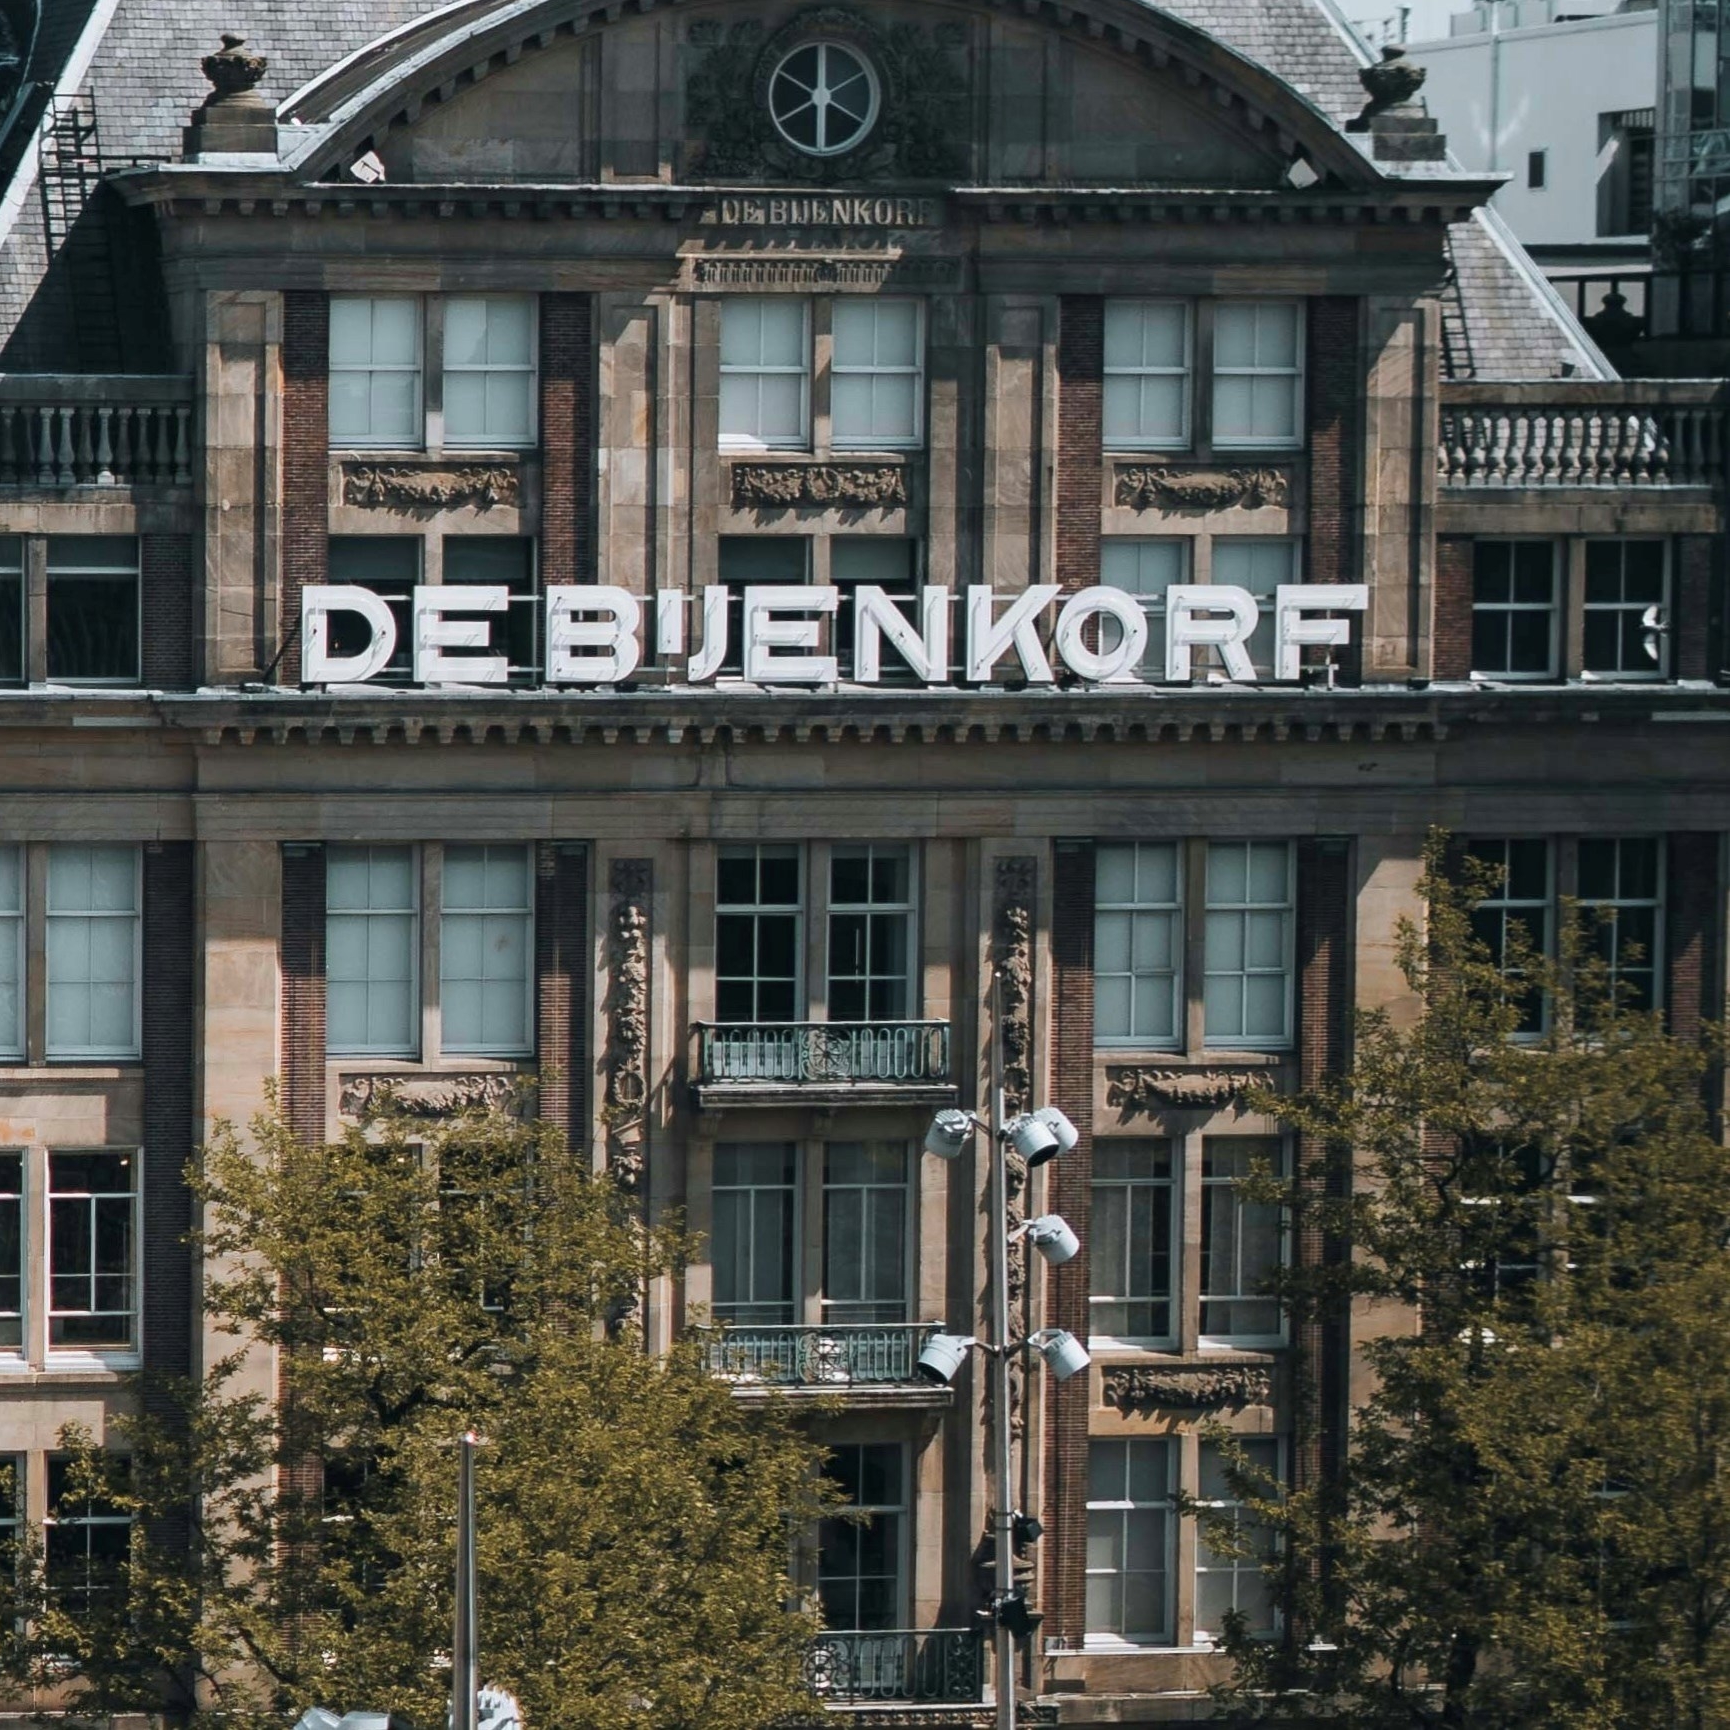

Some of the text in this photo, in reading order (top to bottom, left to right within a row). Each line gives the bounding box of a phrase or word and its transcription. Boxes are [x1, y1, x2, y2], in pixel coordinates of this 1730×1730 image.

[721, 198, 764, 226] DE
[302, 584, 1368, 682] DE BIJENKORF
